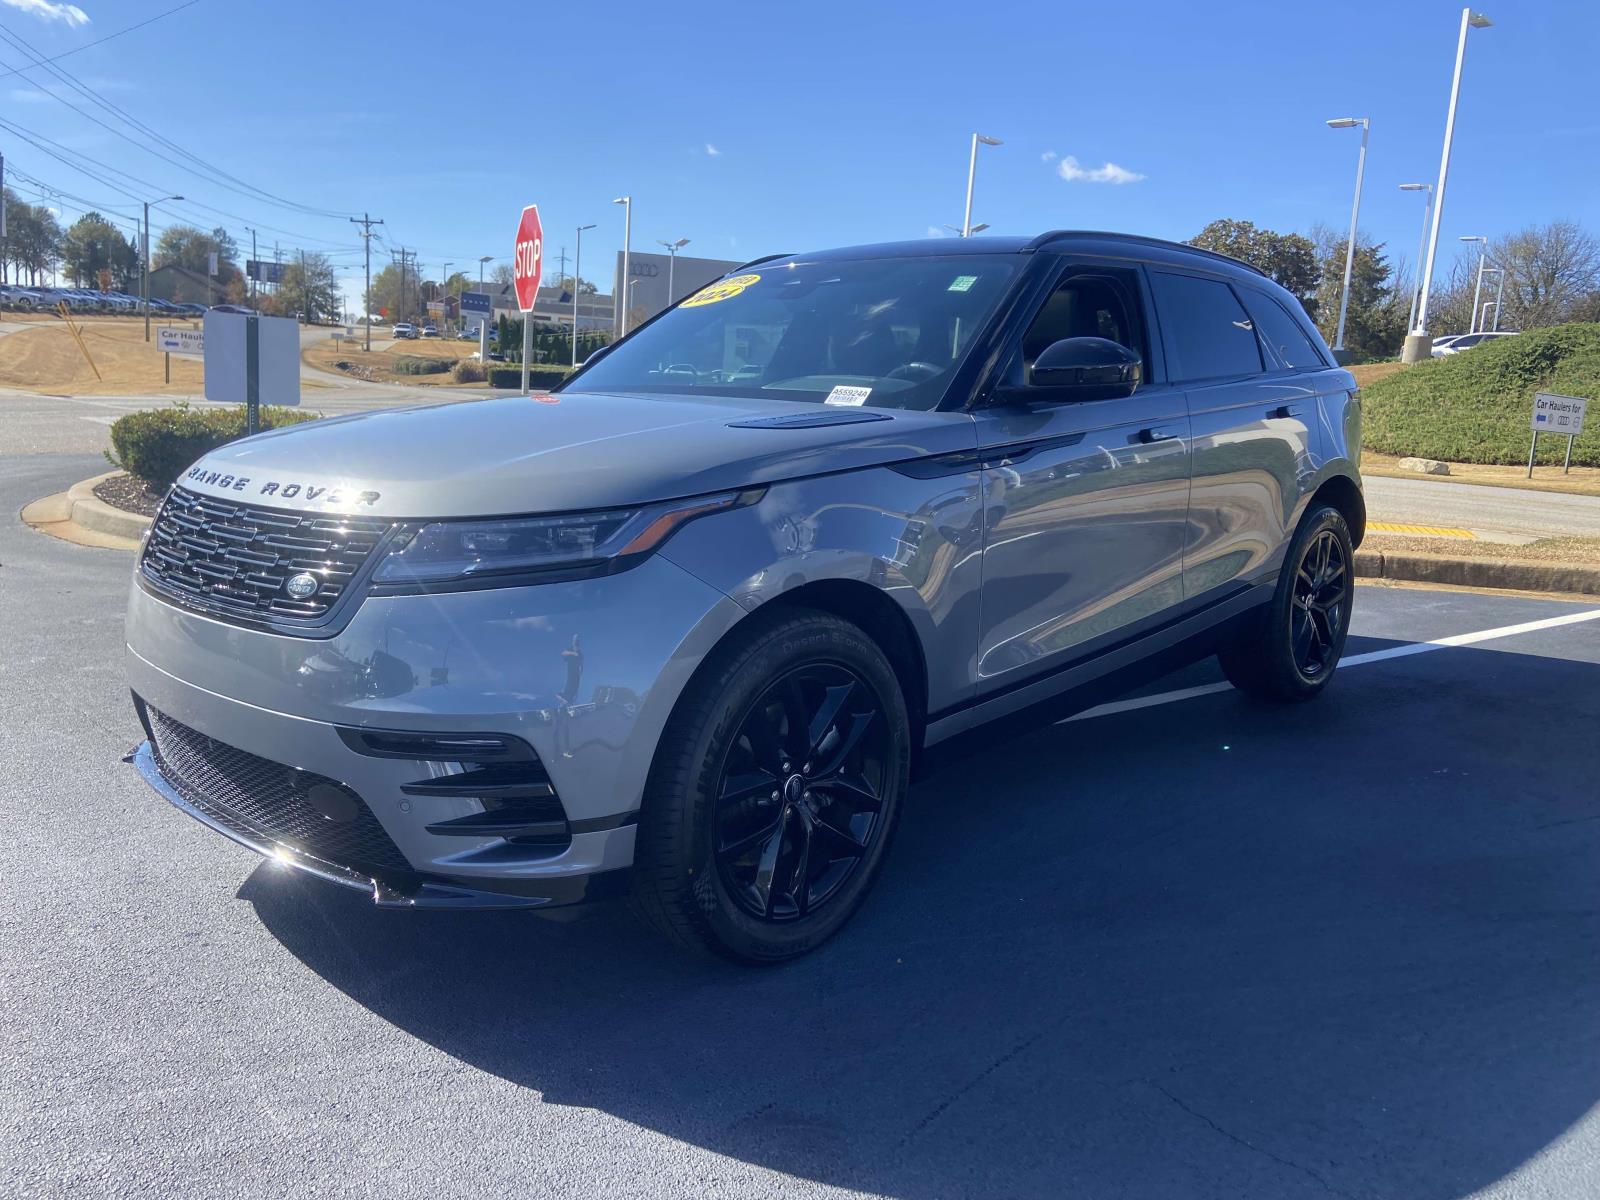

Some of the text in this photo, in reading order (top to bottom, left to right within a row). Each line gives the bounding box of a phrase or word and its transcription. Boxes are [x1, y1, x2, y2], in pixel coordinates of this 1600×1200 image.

[516, 239, 541, 280] STOP
[161, 330, 178, 339] Car
[1536, 399, 1581, 413] Car Haulers for
[188, 466, 251, 491] RANGE
